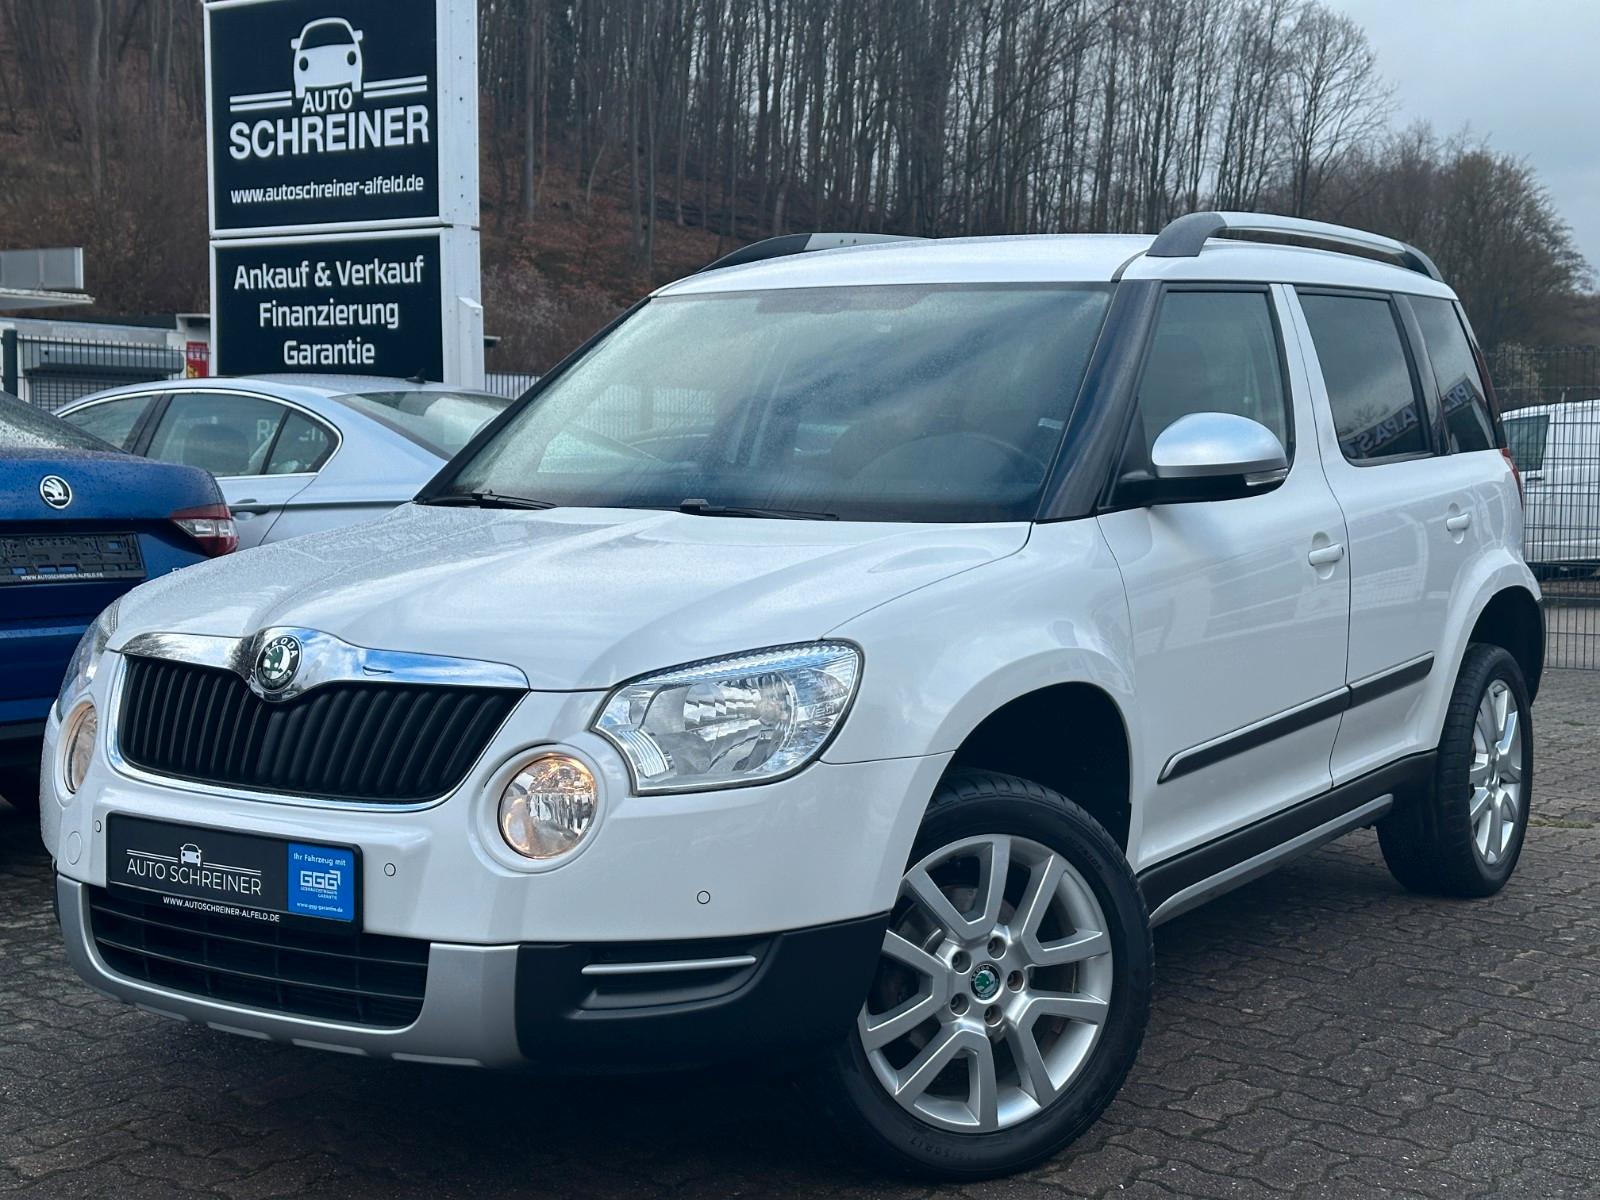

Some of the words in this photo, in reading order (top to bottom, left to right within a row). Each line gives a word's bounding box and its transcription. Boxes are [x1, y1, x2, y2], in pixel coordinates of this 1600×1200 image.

[302, 88, 353, 113] AUTO
[229, 105, 429, 160] SCHREINER
[231, 173, 424, 203] www.autoschreiner-alfeld.de
[234, 260, 309, 290] Ankauf
[315, 262, 332, 287] &
[335, 255, 424, 286] Verkauf
[259, 298, 400, 329] Finanzierung
[283, 337, 376, 366] Garantie
[293, 852, 303, 861] Ihr
[304, 854, 334, 867] Fahrzeug
[335, 859, 346, 867] mit
[126, 858, 166, 880] AUTO
[169, 865, 262, 896] SCHREINER
[300, 870, 340, 891] GGG
[162, 895, 280, 923] WWW.AUTOSCHREINER-ALFELD.DE
